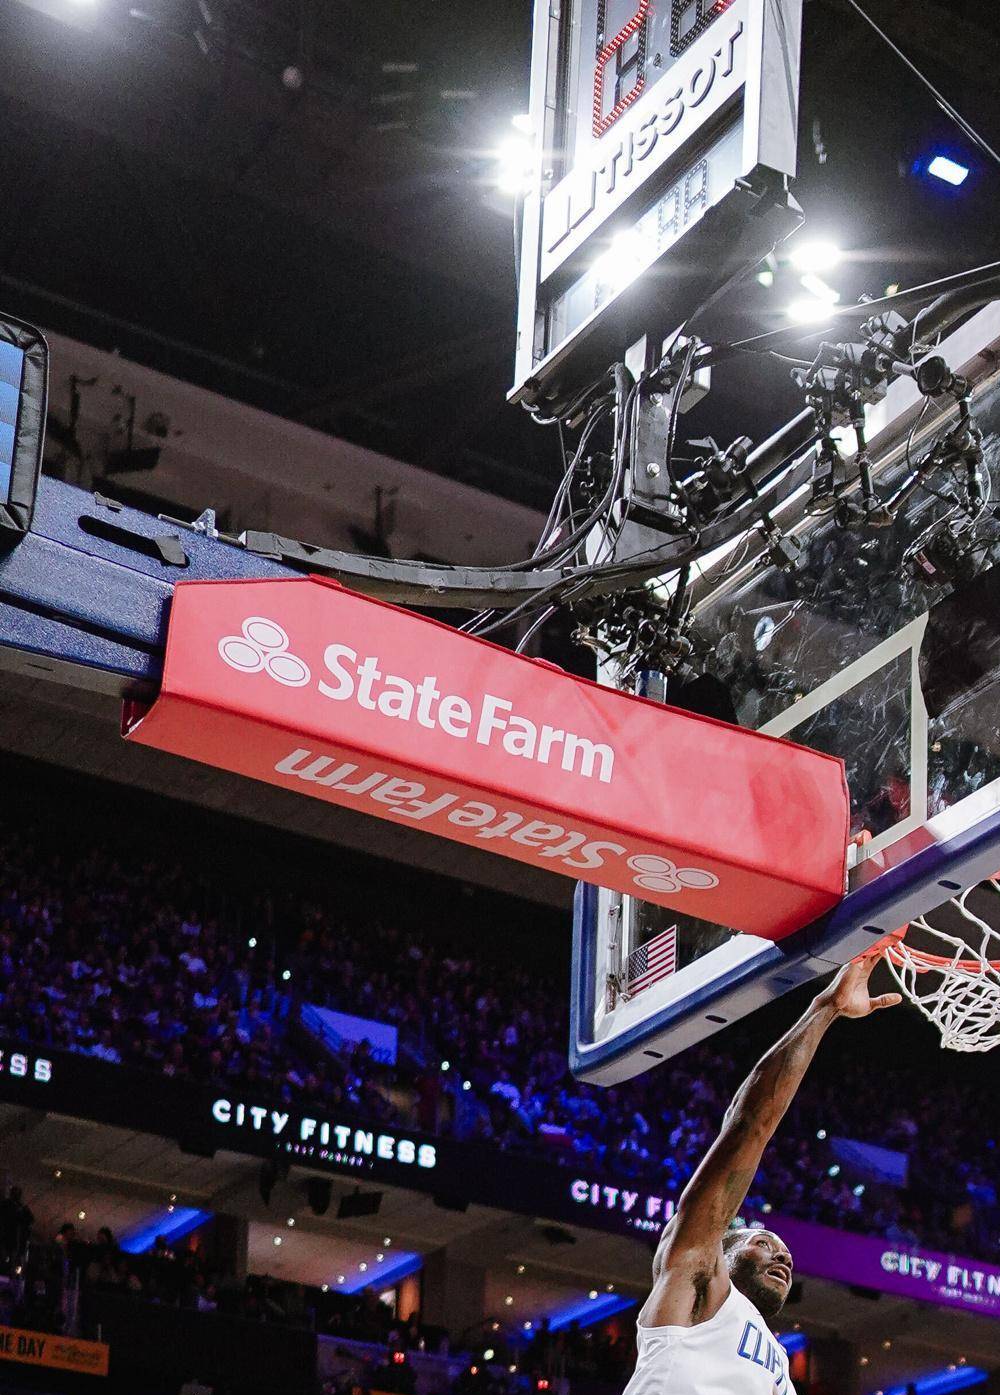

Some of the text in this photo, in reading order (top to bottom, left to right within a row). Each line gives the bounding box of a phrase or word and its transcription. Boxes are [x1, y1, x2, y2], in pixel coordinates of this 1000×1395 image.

[599, 20, 744, 194] TISSOT
[212, 1099, 289, 1134] CITY
[301, 1118, 437, 1168] FITNESS
[570, 1179, 639, 1212] CITY
[880, 1251, 942, 1281] CITY
